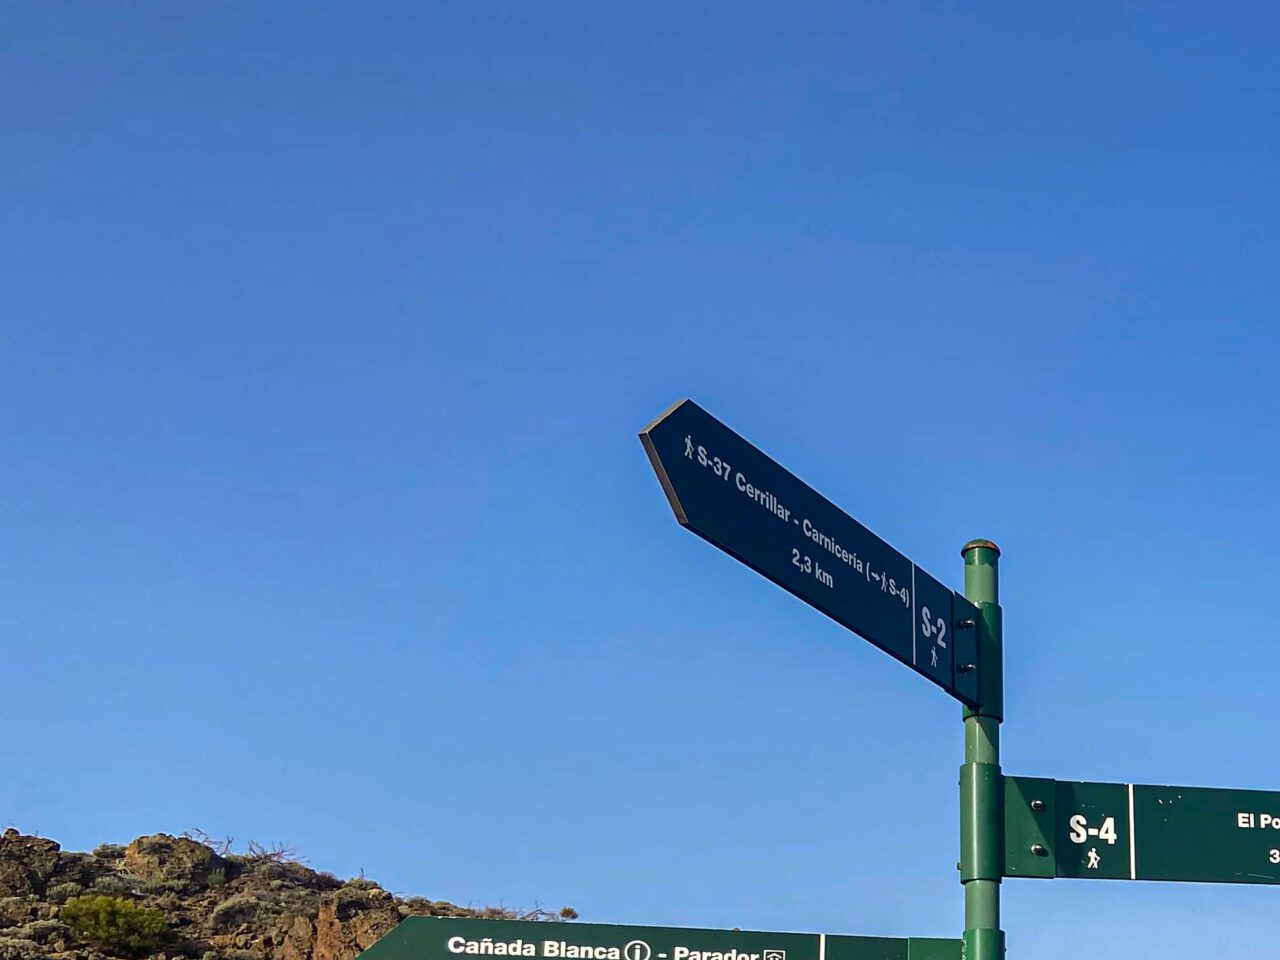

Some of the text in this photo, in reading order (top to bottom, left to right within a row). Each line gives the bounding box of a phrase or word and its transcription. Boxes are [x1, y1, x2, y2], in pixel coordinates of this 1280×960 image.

[697, 445, 731, 481] S-37
[735, 472, 791, 522] Cerrillar
[803, 519, 863, 573] Carnicería
[792, 548, 834, 588] 2,3 km
[922, 606, 947, 649] S-2
[1069, 814, 1118, 845] S-4
[1237, 812, 1255, 828] El
[447, 935, 536, 957] Cañada
[542, 940, 621, 960] Blanca
